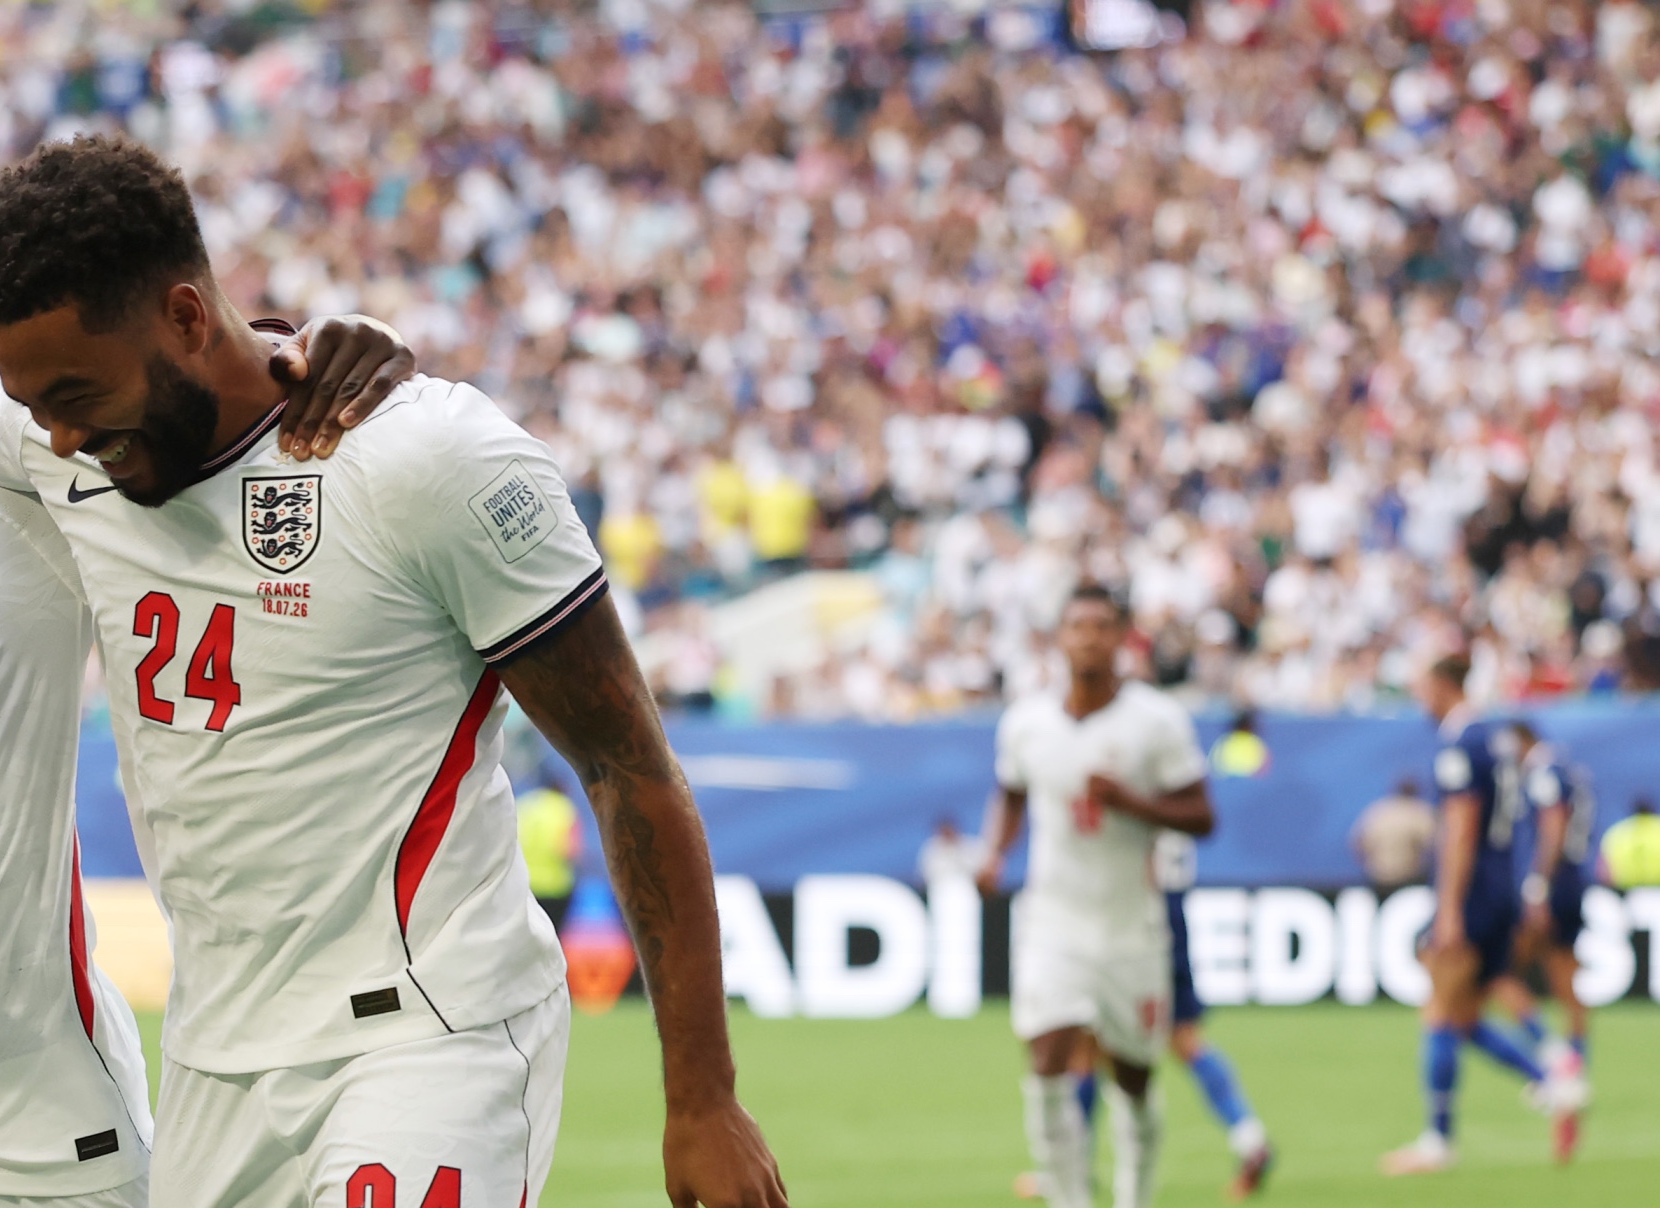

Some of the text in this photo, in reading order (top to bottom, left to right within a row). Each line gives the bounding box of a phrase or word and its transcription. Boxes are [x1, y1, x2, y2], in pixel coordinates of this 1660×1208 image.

[482, 474, 525, 514] FOOTBALL
[490, 484, 535, 528] UNITES
[500, 497, 546, 543] the World
[521, 525, 539, 542] FIFA
[256, 581, 311, 598] FRANCE
[262, 598, 308, 617] 18.07.26
[132, 591, 241, 732] 24
